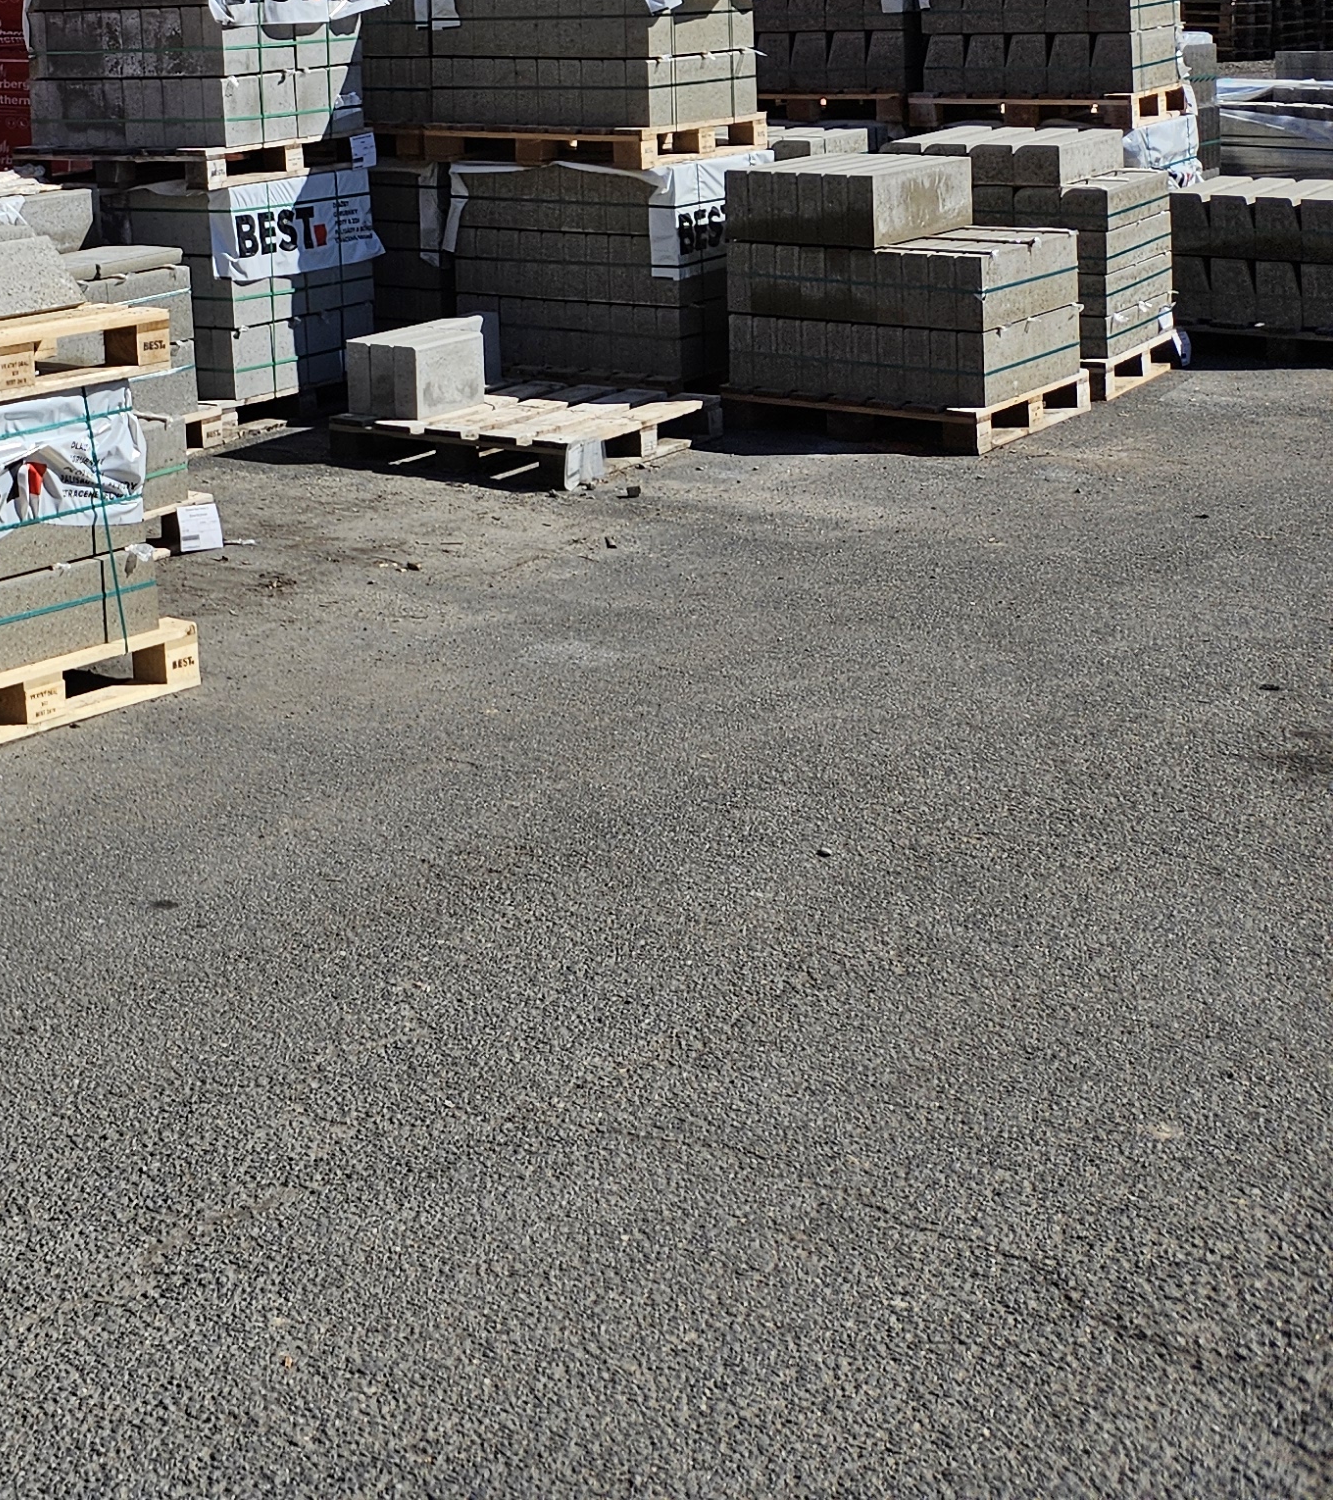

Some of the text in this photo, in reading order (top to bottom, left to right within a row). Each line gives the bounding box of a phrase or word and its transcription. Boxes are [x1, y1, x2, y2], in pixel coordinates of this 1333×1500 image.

[235, 206, 314, 258] BEST
[143, 340, 163, 351] BEST
[172, 656, 192, 669] BEST
